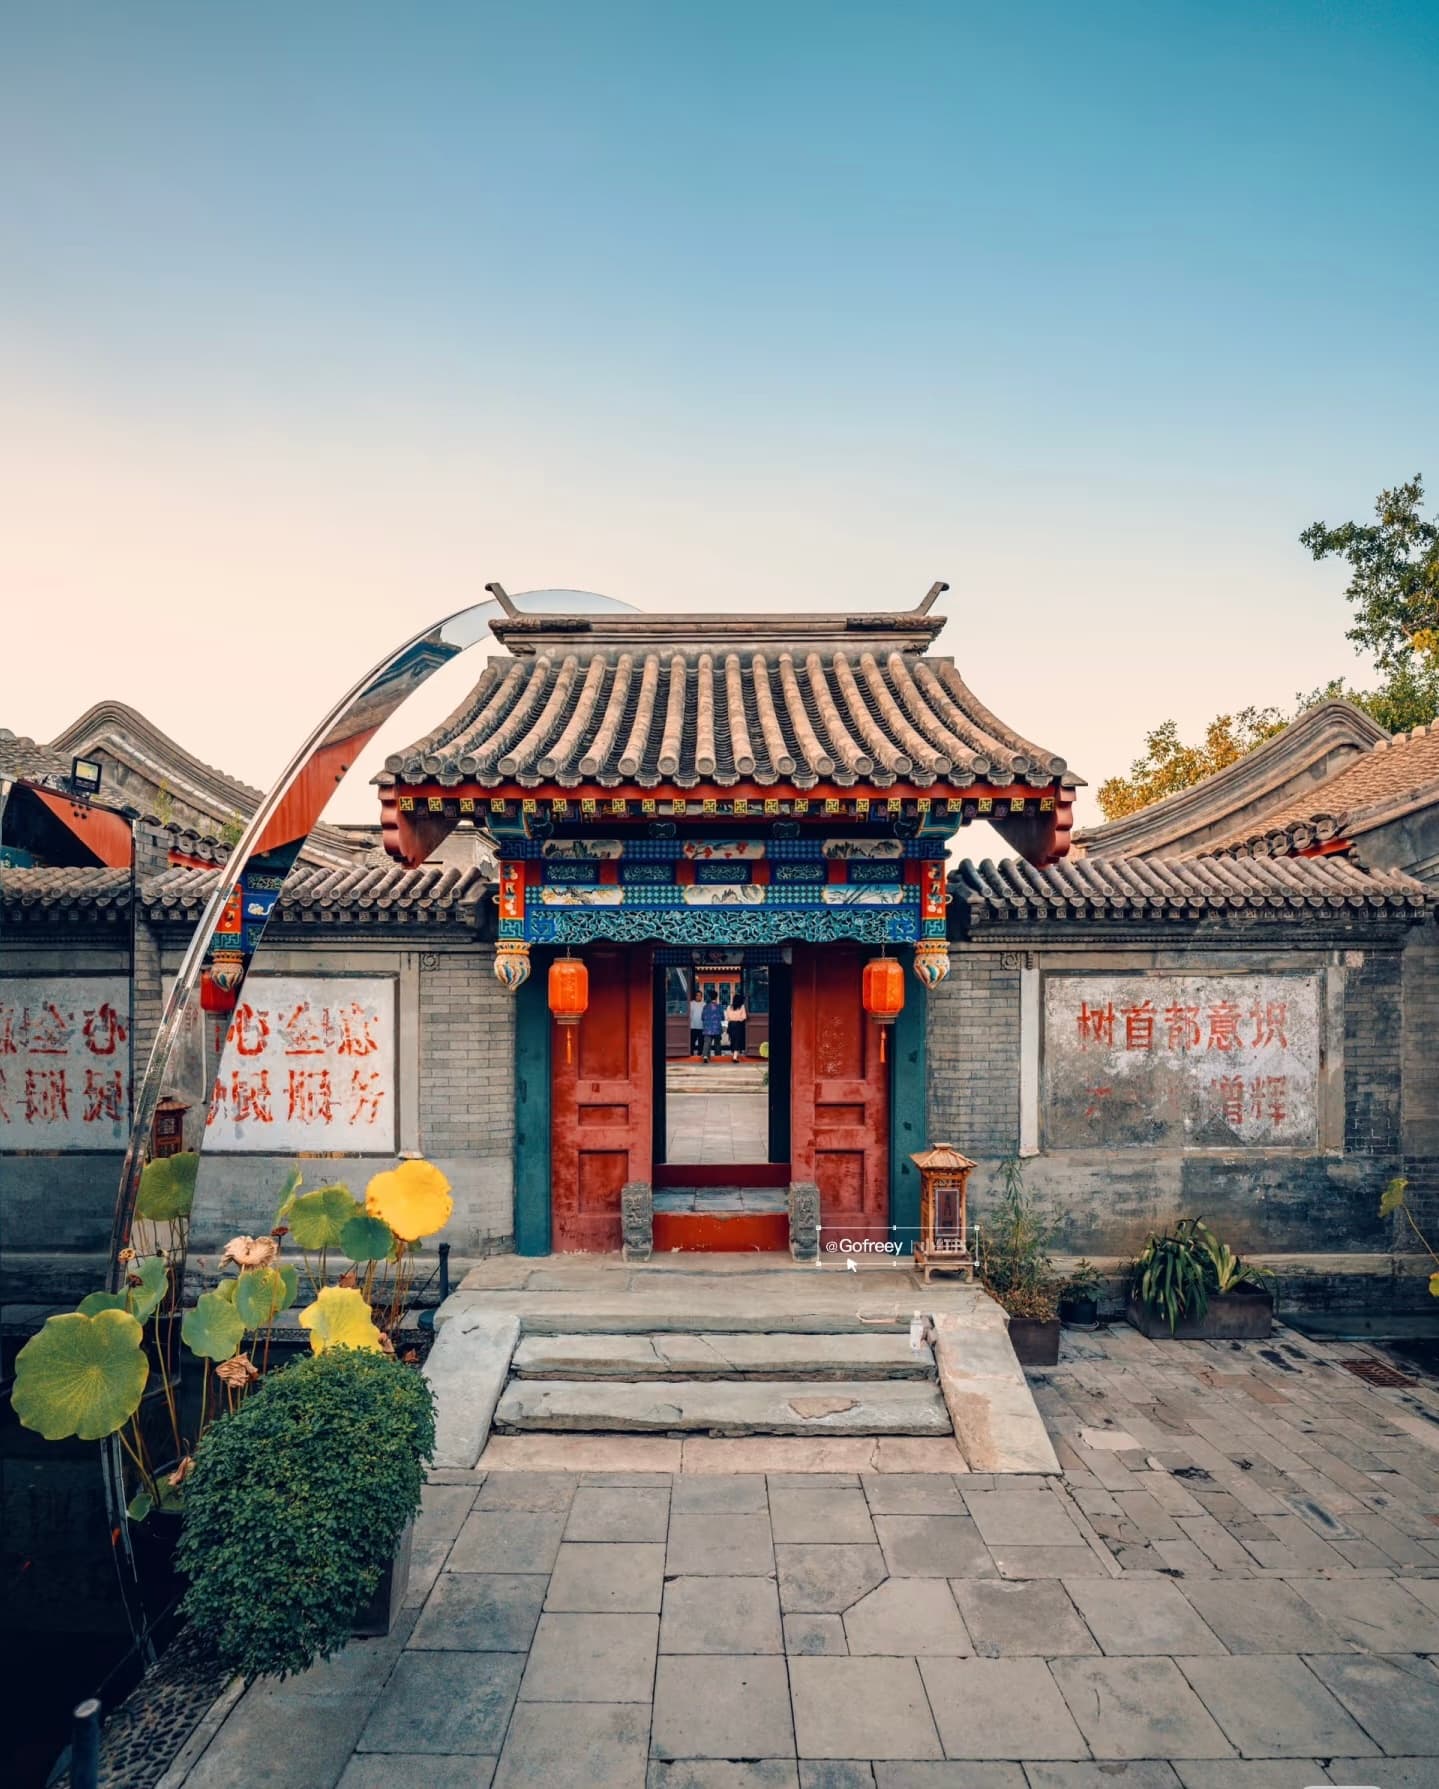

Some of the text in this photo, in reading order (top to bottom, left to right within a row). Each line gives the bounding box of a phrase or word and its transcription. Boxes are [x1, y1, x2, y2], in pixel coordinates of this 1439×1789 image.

[1076, 1000, 1288, 1051] 树首都意识
